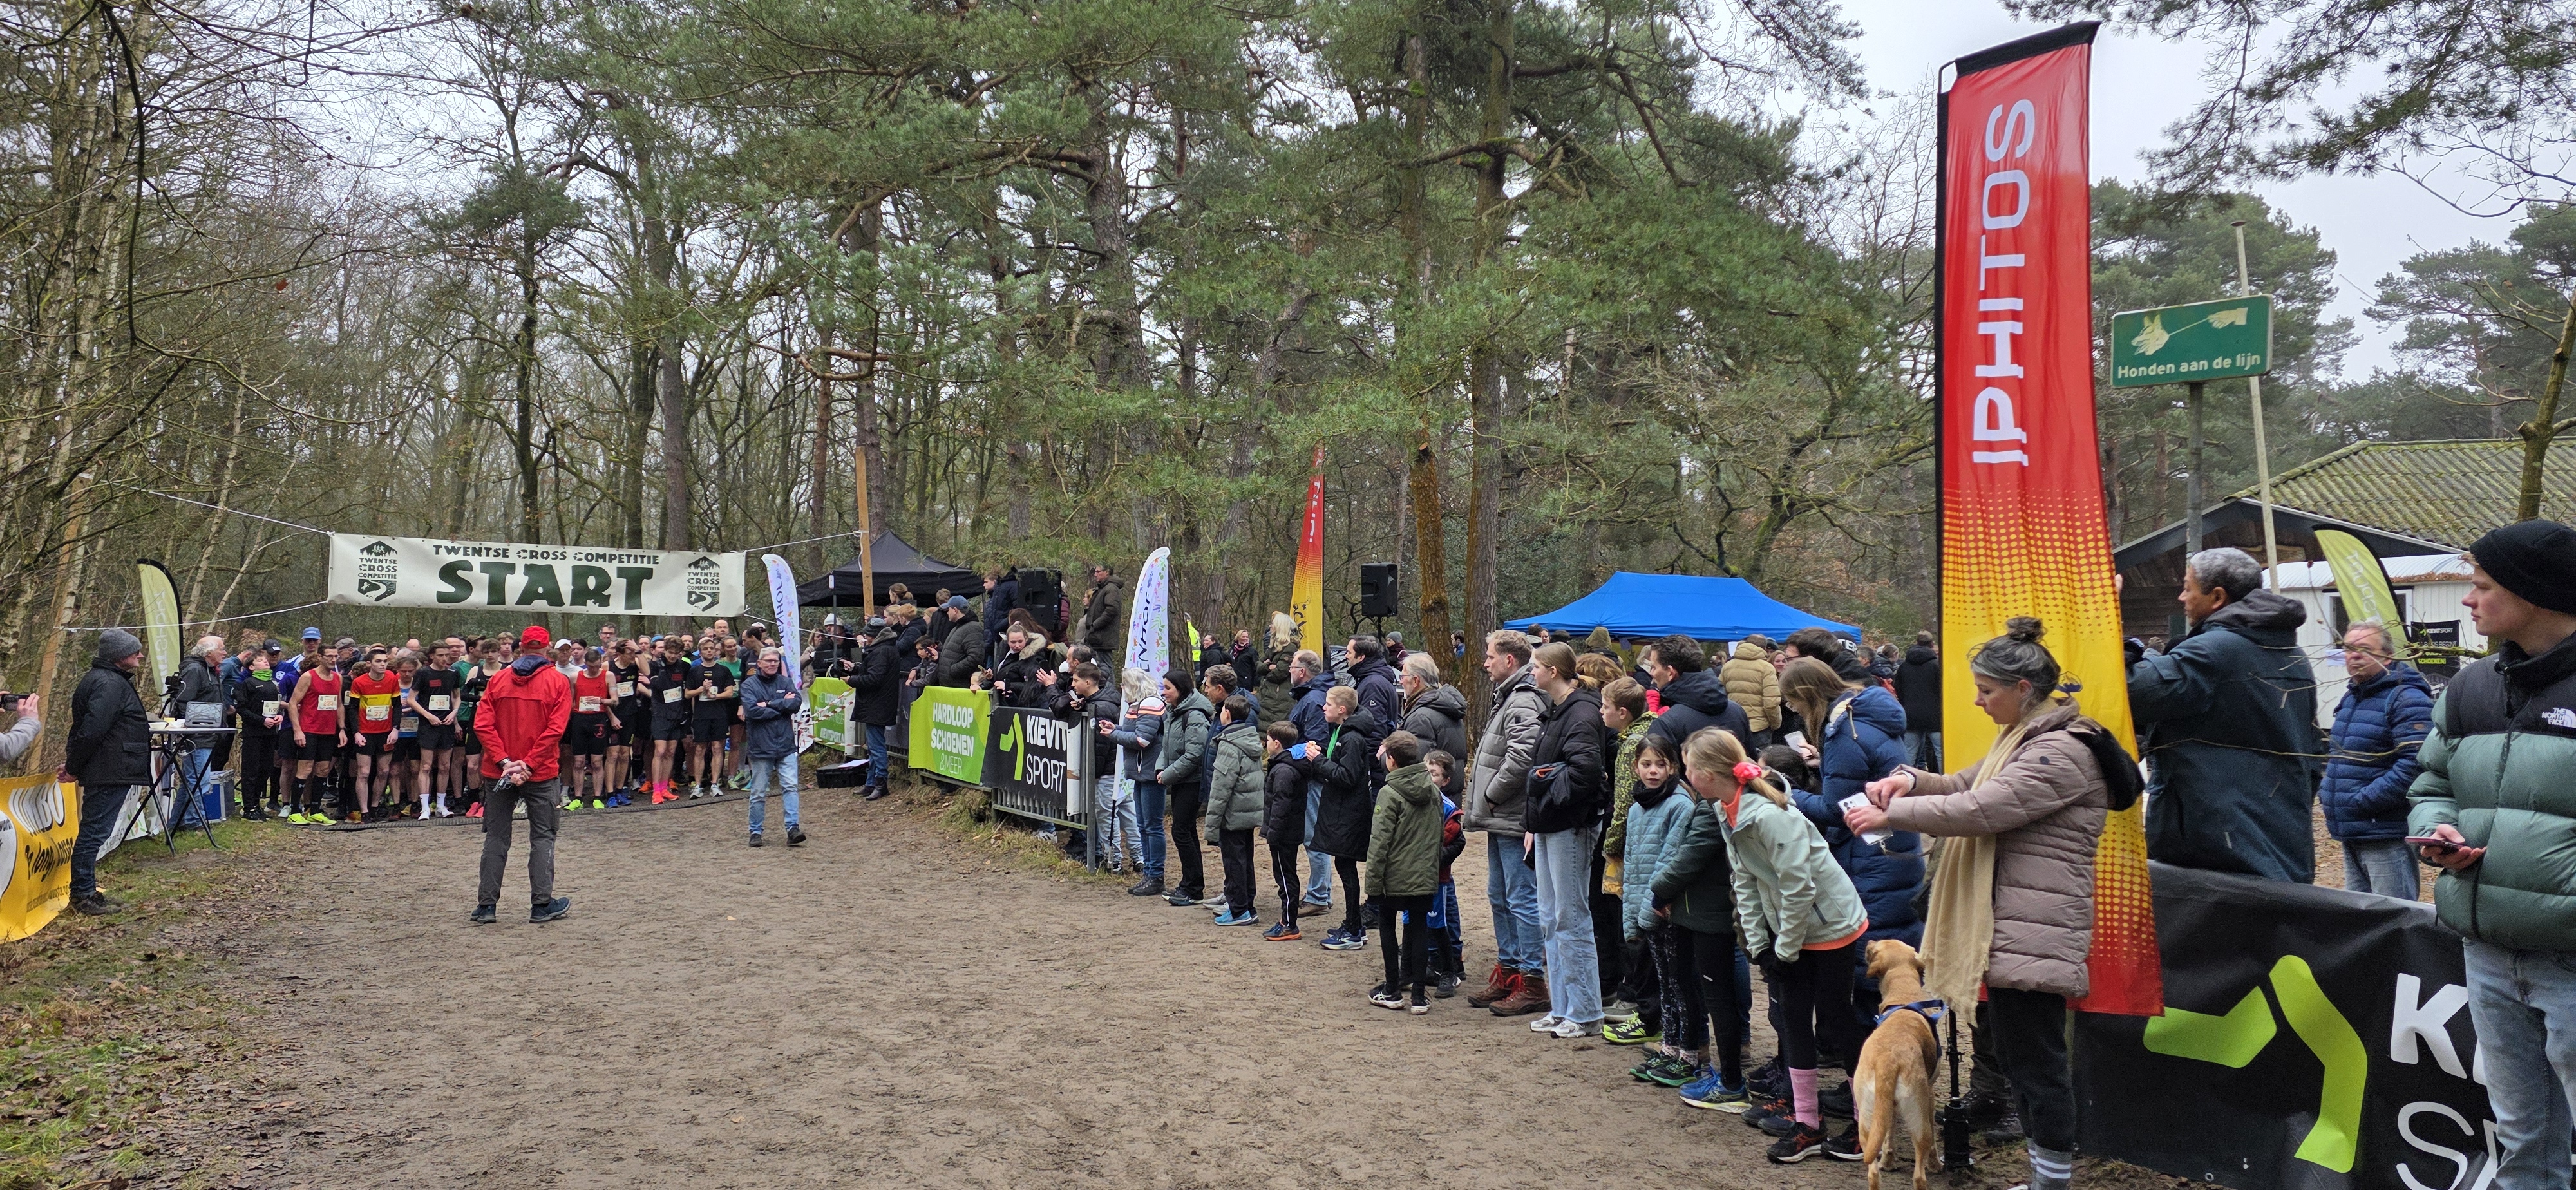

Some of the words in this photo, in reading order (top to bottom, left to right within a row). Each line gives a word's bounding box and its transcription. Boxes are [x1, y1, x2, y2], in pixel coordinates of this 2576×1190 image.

[1973, 99, 2035, 467] IPHITOS
[2117, 363, 2175, 379] Honden
[2179, 359, 2208, 372] aan
[2212, 356, 2232, 369] de
[2235, 353, 2261, 370] lijn
[358, 563, 397, 573] CROSS
[433, 545, 509, 558] TWENTSE
[516, 549, 567, 560] CROSS
[573, 551, 659, 565] COMPETITIE
[436, 560, 654, 610] START
[687, 577, 720, 585] CROSS
[933, 702, 974, 728] HARDLOOP
[2541, 712, 2564, 721] NORTH
[931, 728, 974, 757] SCHOENEN
[1026, 714, 1068, 751] KIEVIT
[939, 753, 963, 775] &MEER
[1026, 753, 1066, 793] SPORT
[2390, 972, 2487, 1086] K
